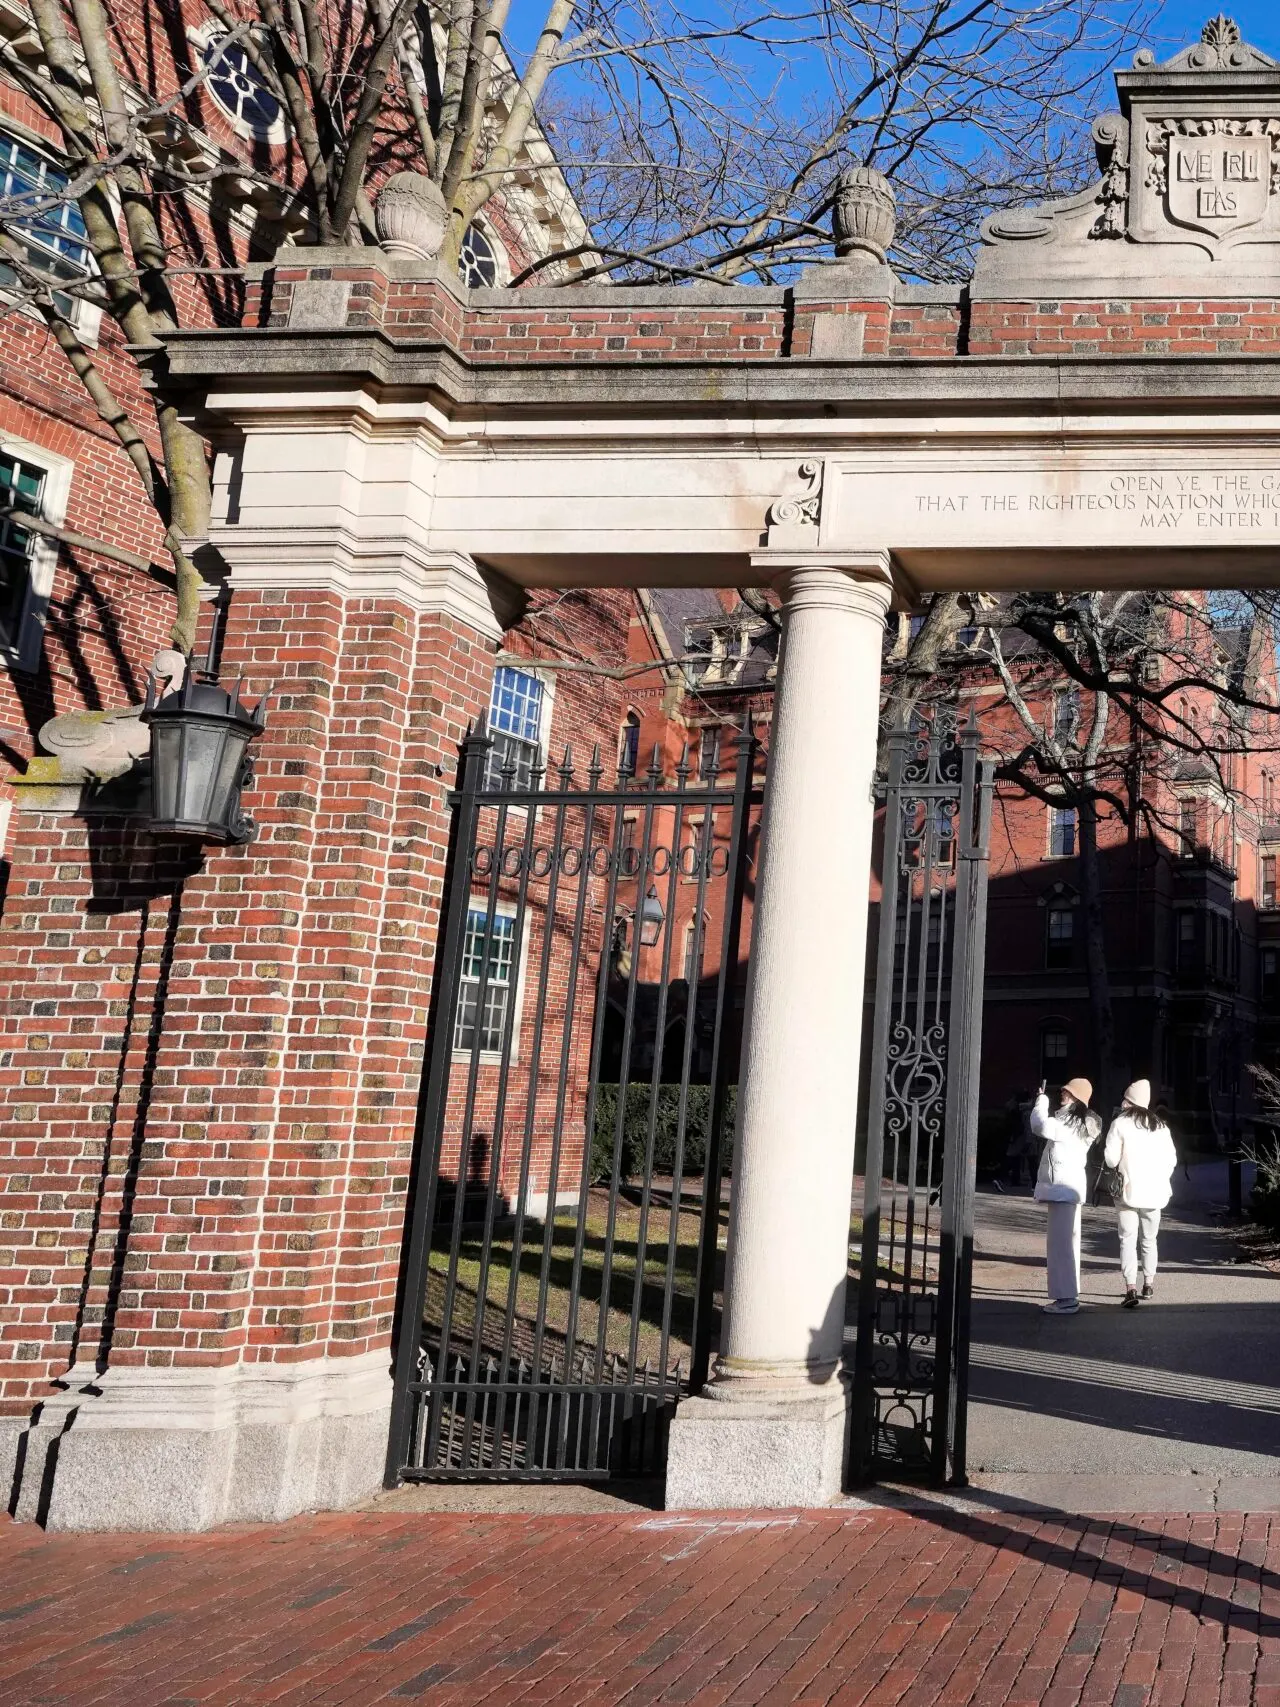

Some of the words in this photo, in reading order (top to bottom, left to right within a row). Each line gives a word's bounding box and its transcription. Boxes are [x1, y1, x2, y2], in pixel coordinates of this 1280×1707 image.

[1202, 191, 1237, 212] TAS
[1110, 475, 1163, 492] OPEN
[1176, 475, 1201, 491] YE
[1212, 475, 1251, 491] THE
[915, 495, 969, 512] THAT
[981, 495, 1019, 511] THE
[1029, 494, 1136, 511] RIGHTEOUS
[1146, 493, 1224, 510] NATION
[1140, 512, 1183, 528] MAY
[1197, 512, 1263, 528] ENTER
